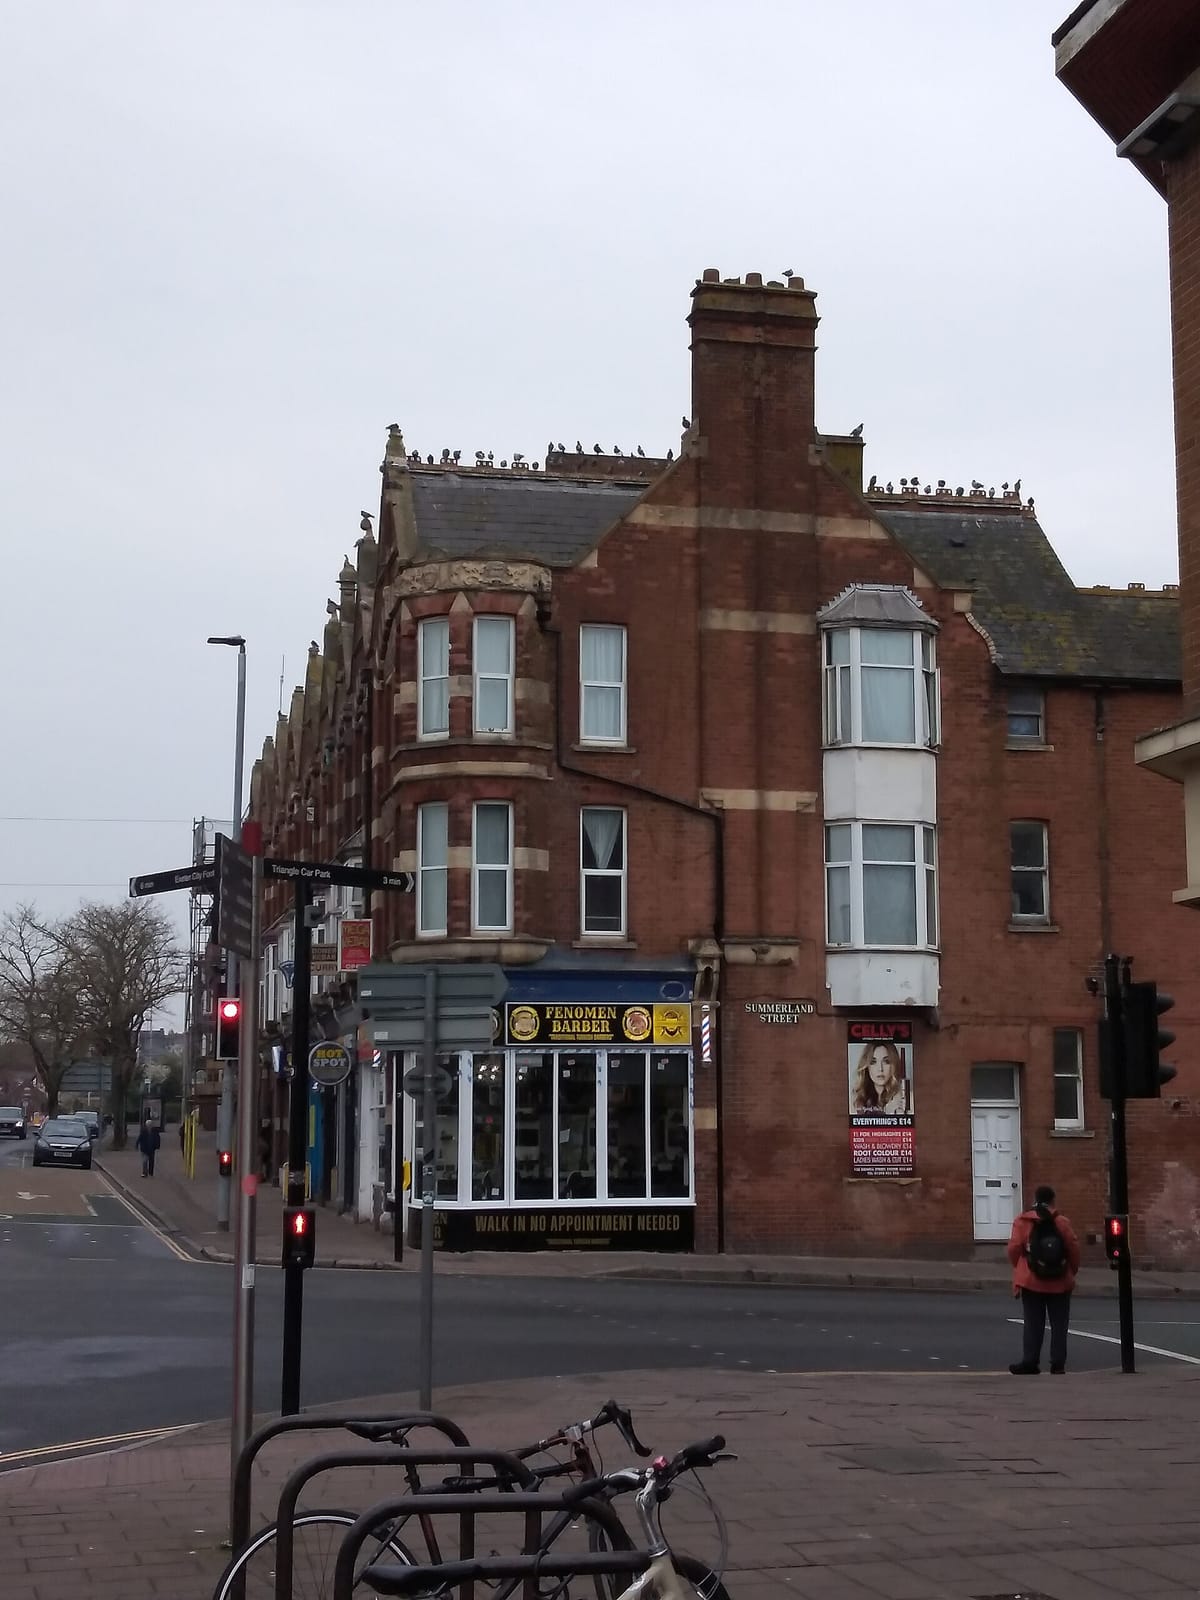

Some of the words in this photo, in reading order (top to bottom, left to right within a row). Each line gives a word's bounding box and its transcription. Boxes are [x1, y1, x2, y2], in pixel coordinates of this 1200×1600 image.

[271, 864, 299, 877] Triangle
[300, 867, 314, 877] Car
[314, 869, 331, 879] Park
[382, 876, 388, 885] 3
[545, 1006, 617, 1019] FENOMEN
[744, 1003, 814, 1014] SUMMERLAND
[759, 1014, 799, 1023] STREET
[551, 1020, 610, 1033] BARBER
[851, 1024, 910, 1037] CELLY'S
[315, 1049, 344, 1058] HOT
[313, 1058, 346, 1067] SPOT
[852, 1117, 898, 1126] EVERYTHING'S
[899, 1117, 912, 1126] £14
[475, 1215, 509, 1232] WALK
[513, 1215, 526, 1232] IN
[530, 1215, 547, 1232] NO
[550, 1215, 633, 1232] APPOINTMENT
[637, 1214, 680, 1231] NEEDED
